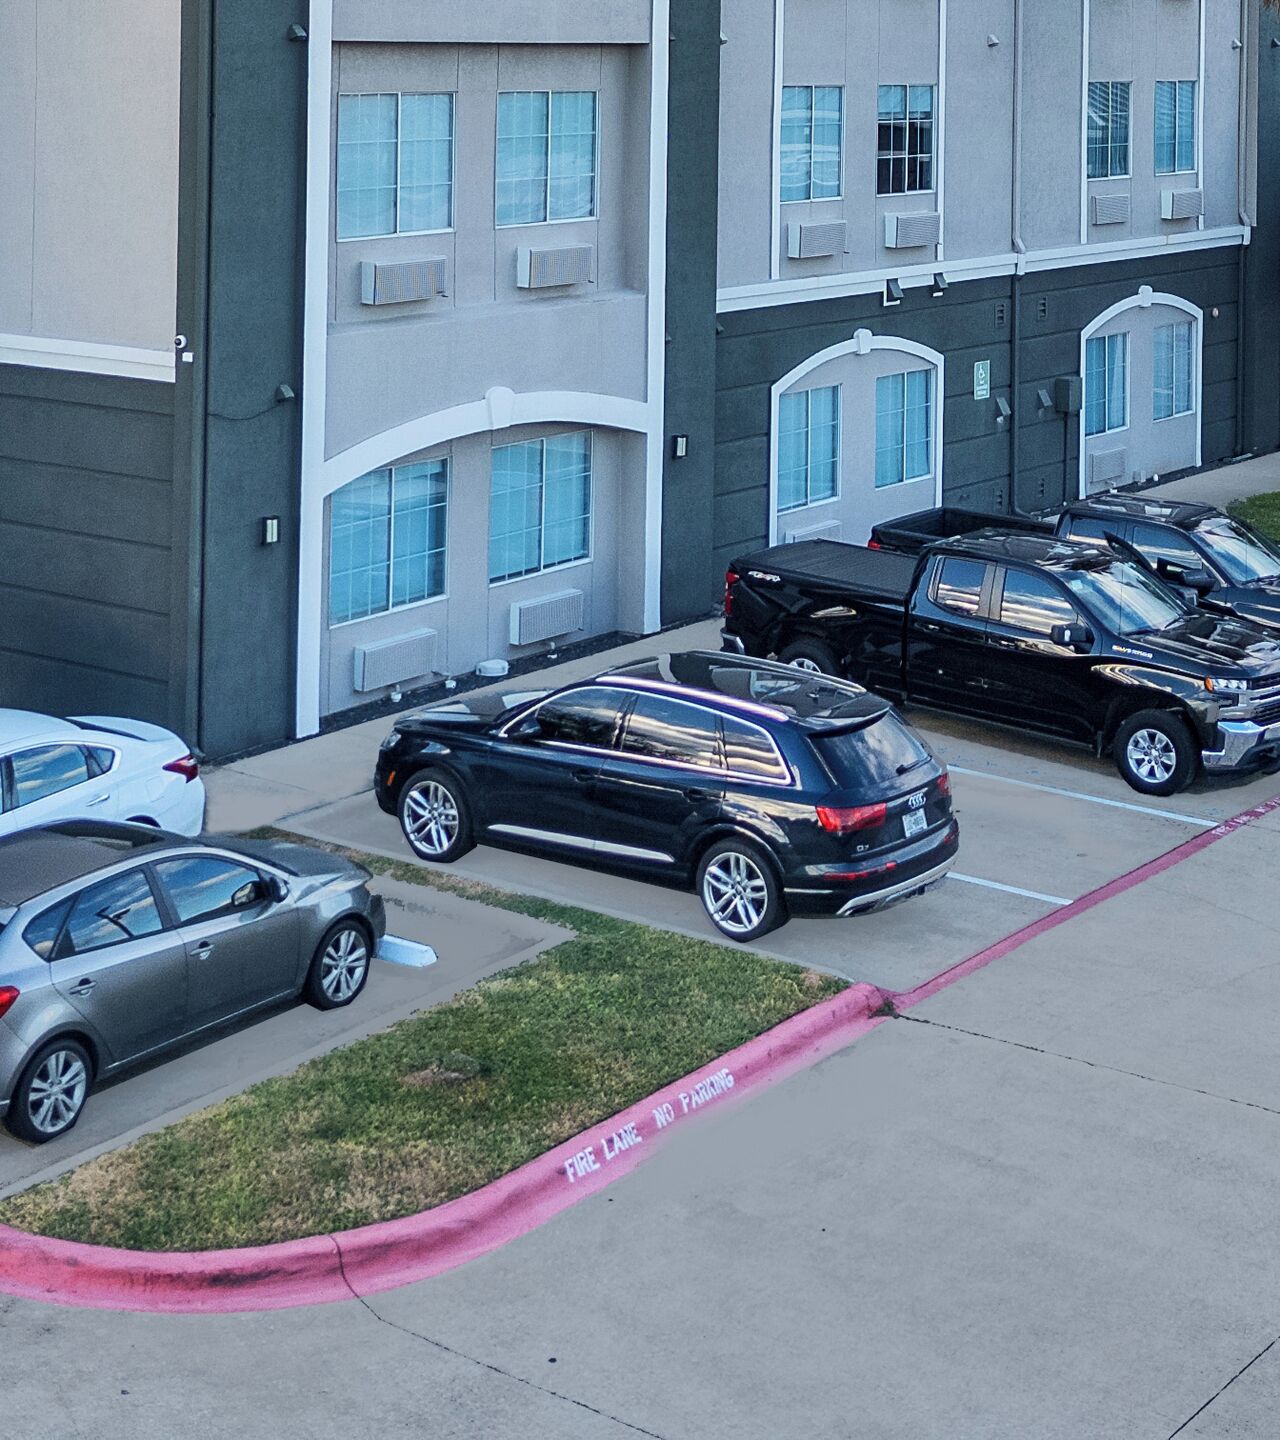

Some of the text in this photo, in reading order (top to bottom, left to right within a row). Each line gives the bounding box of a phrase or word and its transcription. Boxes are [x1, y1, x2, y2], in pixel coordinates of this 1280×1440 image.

[564, 1068, 735, 1183] FIRE LANE NO PARKING
